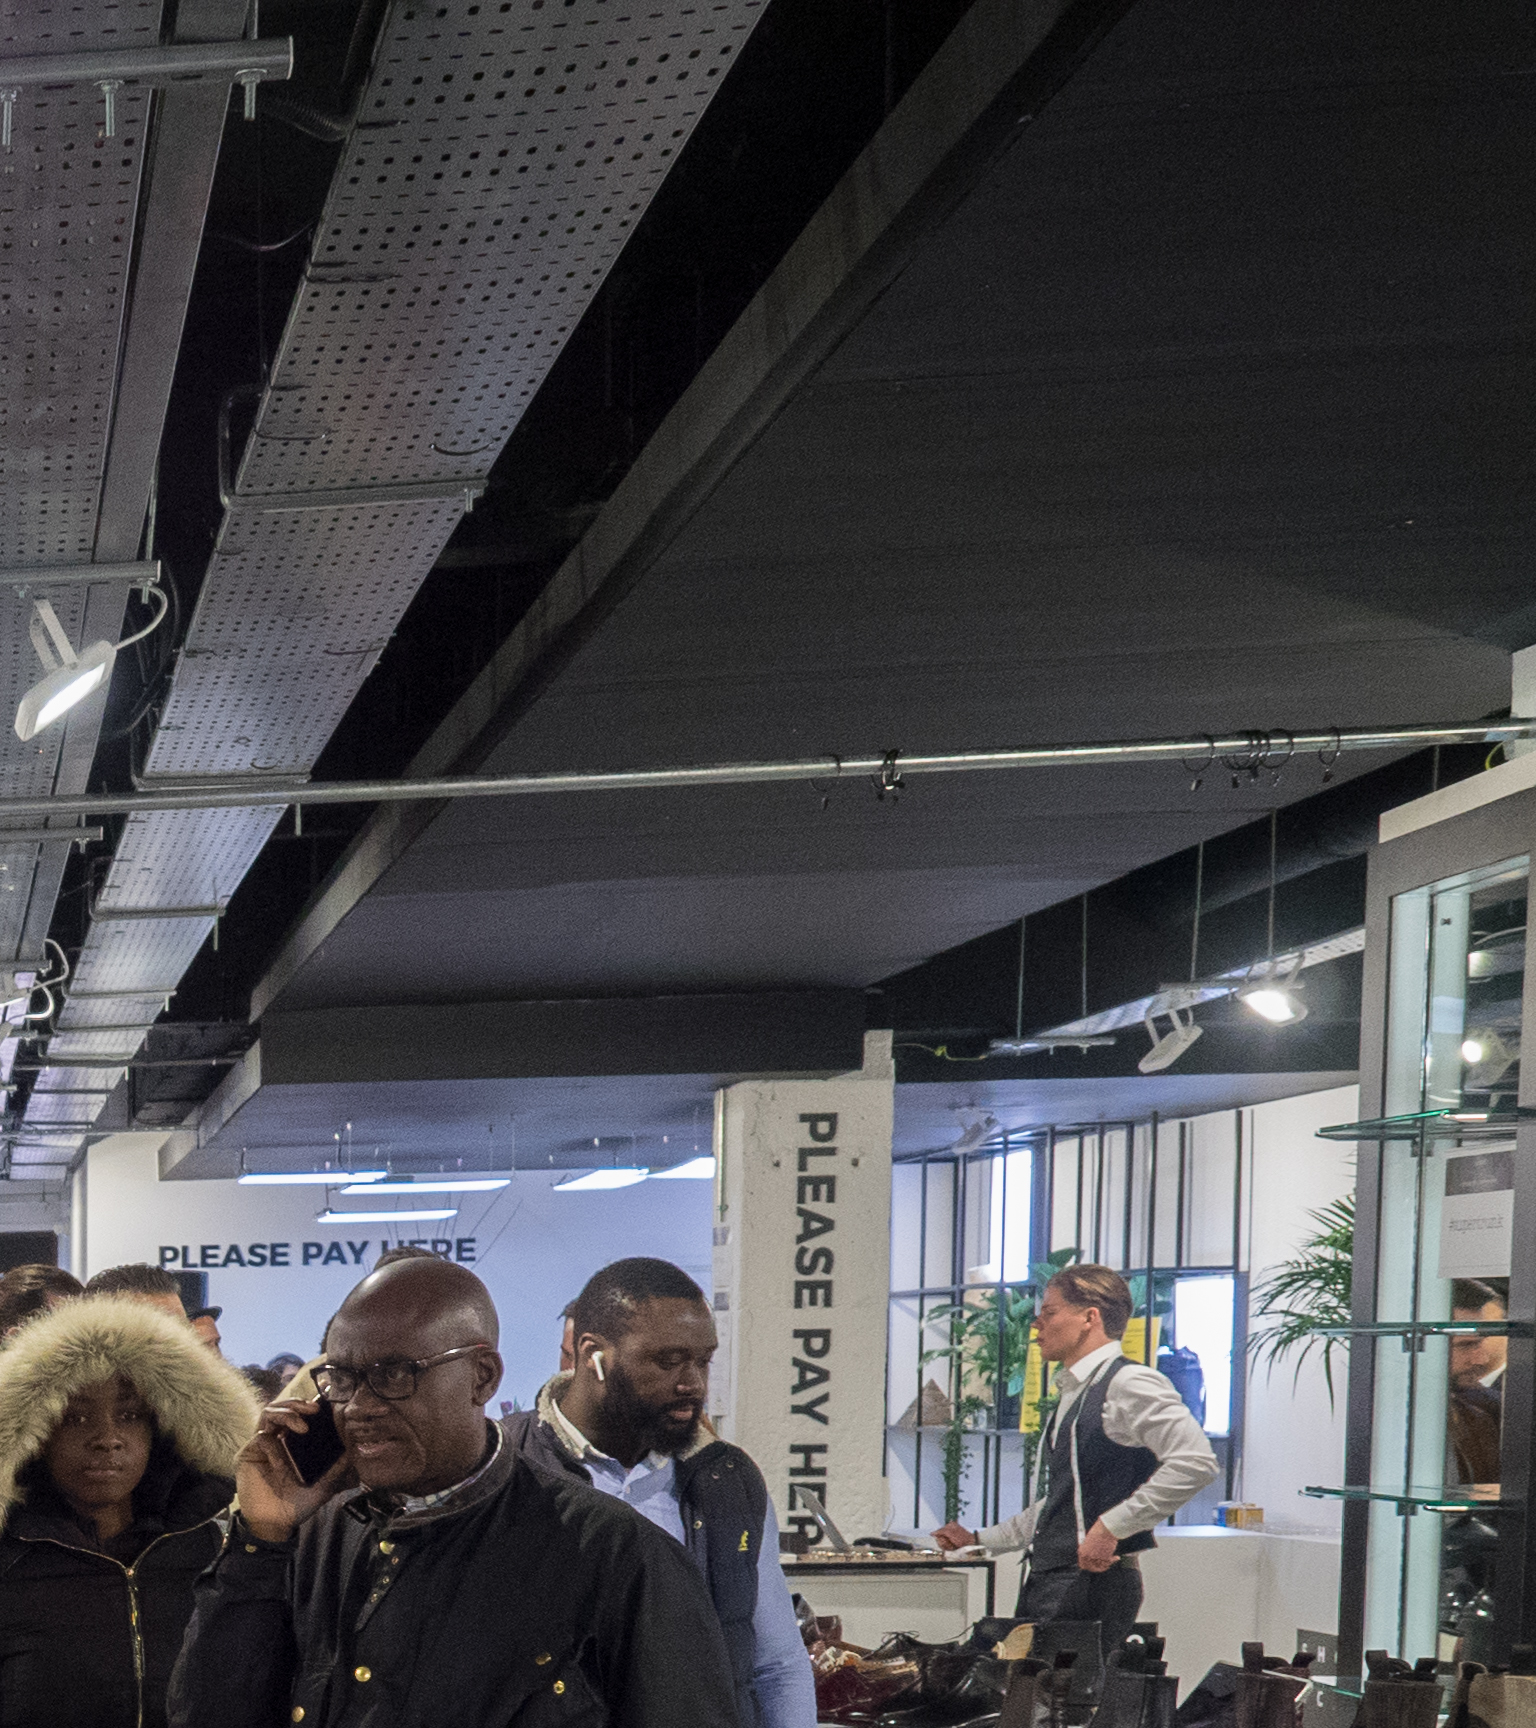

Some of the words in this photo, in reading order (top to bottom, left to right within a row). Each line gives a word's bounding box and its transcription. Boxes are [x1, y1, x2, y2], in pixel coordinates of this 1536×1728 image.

[159, 1243, 290, 1268] PLEASE
[302, 1241, 369, 1265] PAY
[381, 1237, 477, 1262] RE
[794, 1112, 838, 1309] PLEASE
[791, 1328, 832, 1426] PAY
